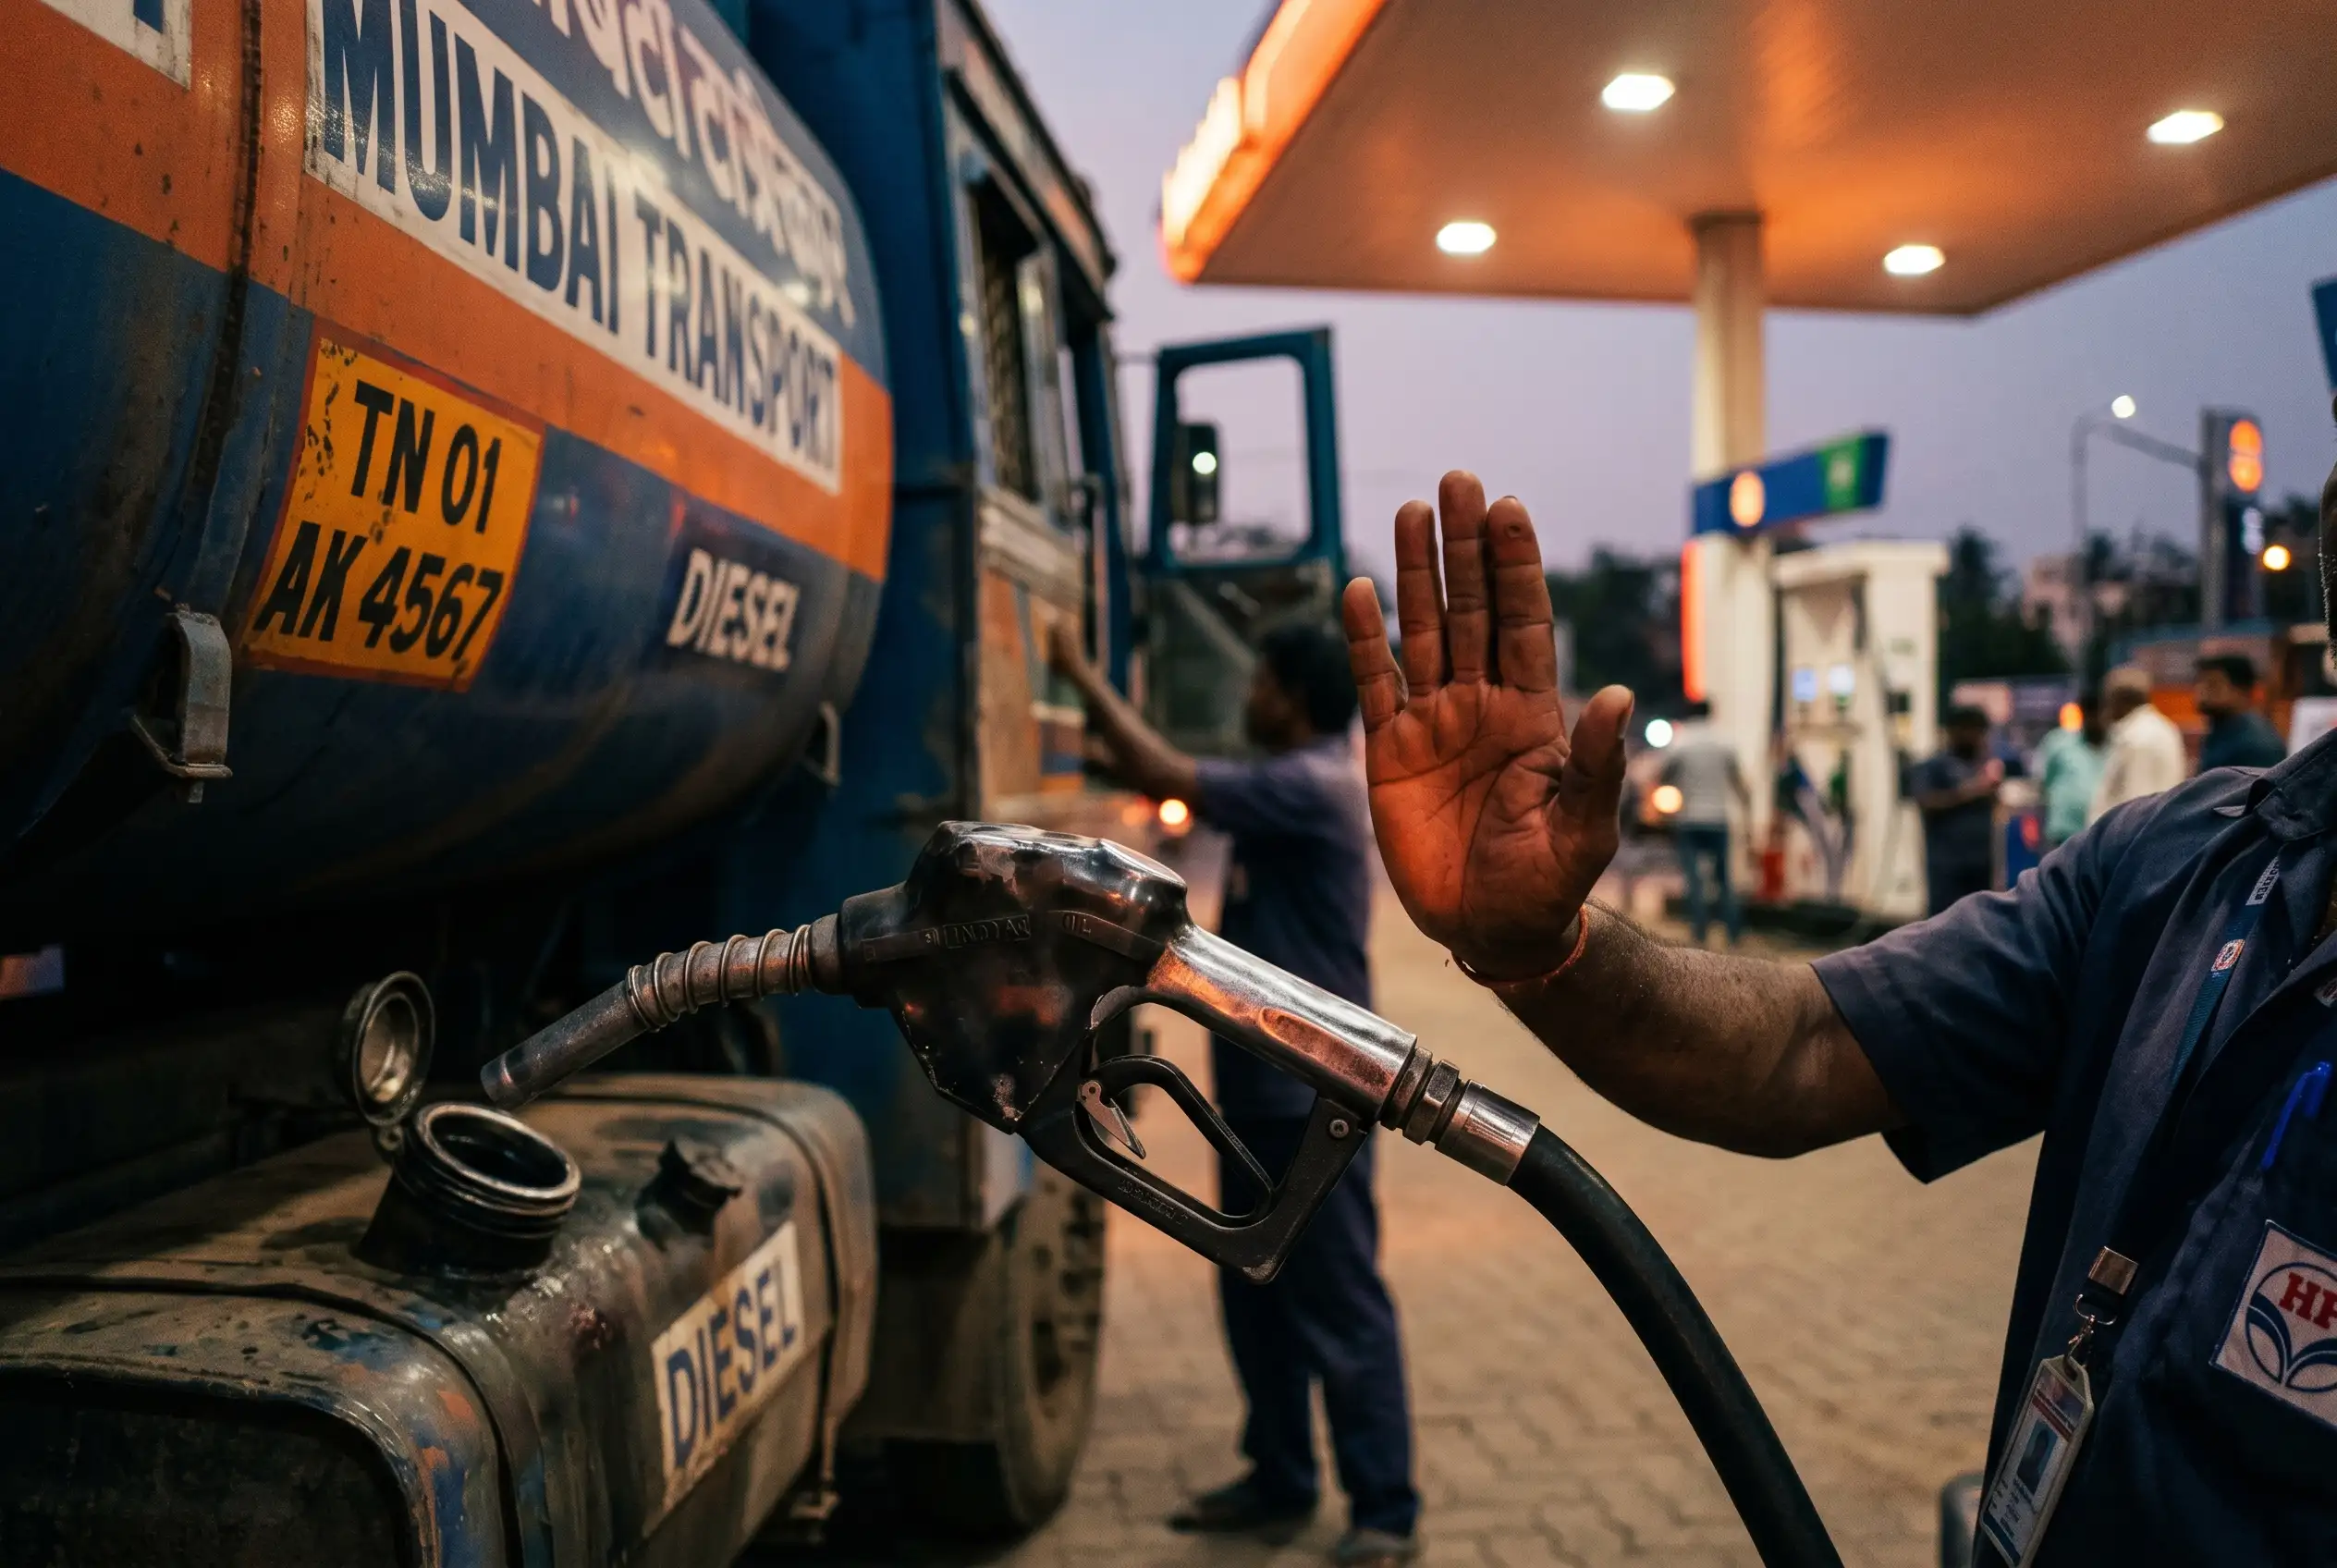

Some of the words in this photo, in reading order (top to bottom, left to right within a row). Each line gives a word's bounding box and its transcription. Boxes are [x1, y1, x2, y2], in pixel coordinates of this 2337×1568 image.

[323, 0, 618, 336] MUMBAI
[634, 188, 835, 470] TRANSPORT
[350, 378, 435, 514] TN
[441, 423, 502, 534] 01
[252, 520, 368, 642] AK
[358, 546, 505, 662] 4567
[666, 547, 801, 672] DIESEL
[667, 1256, 797, 1467] DIESEL
